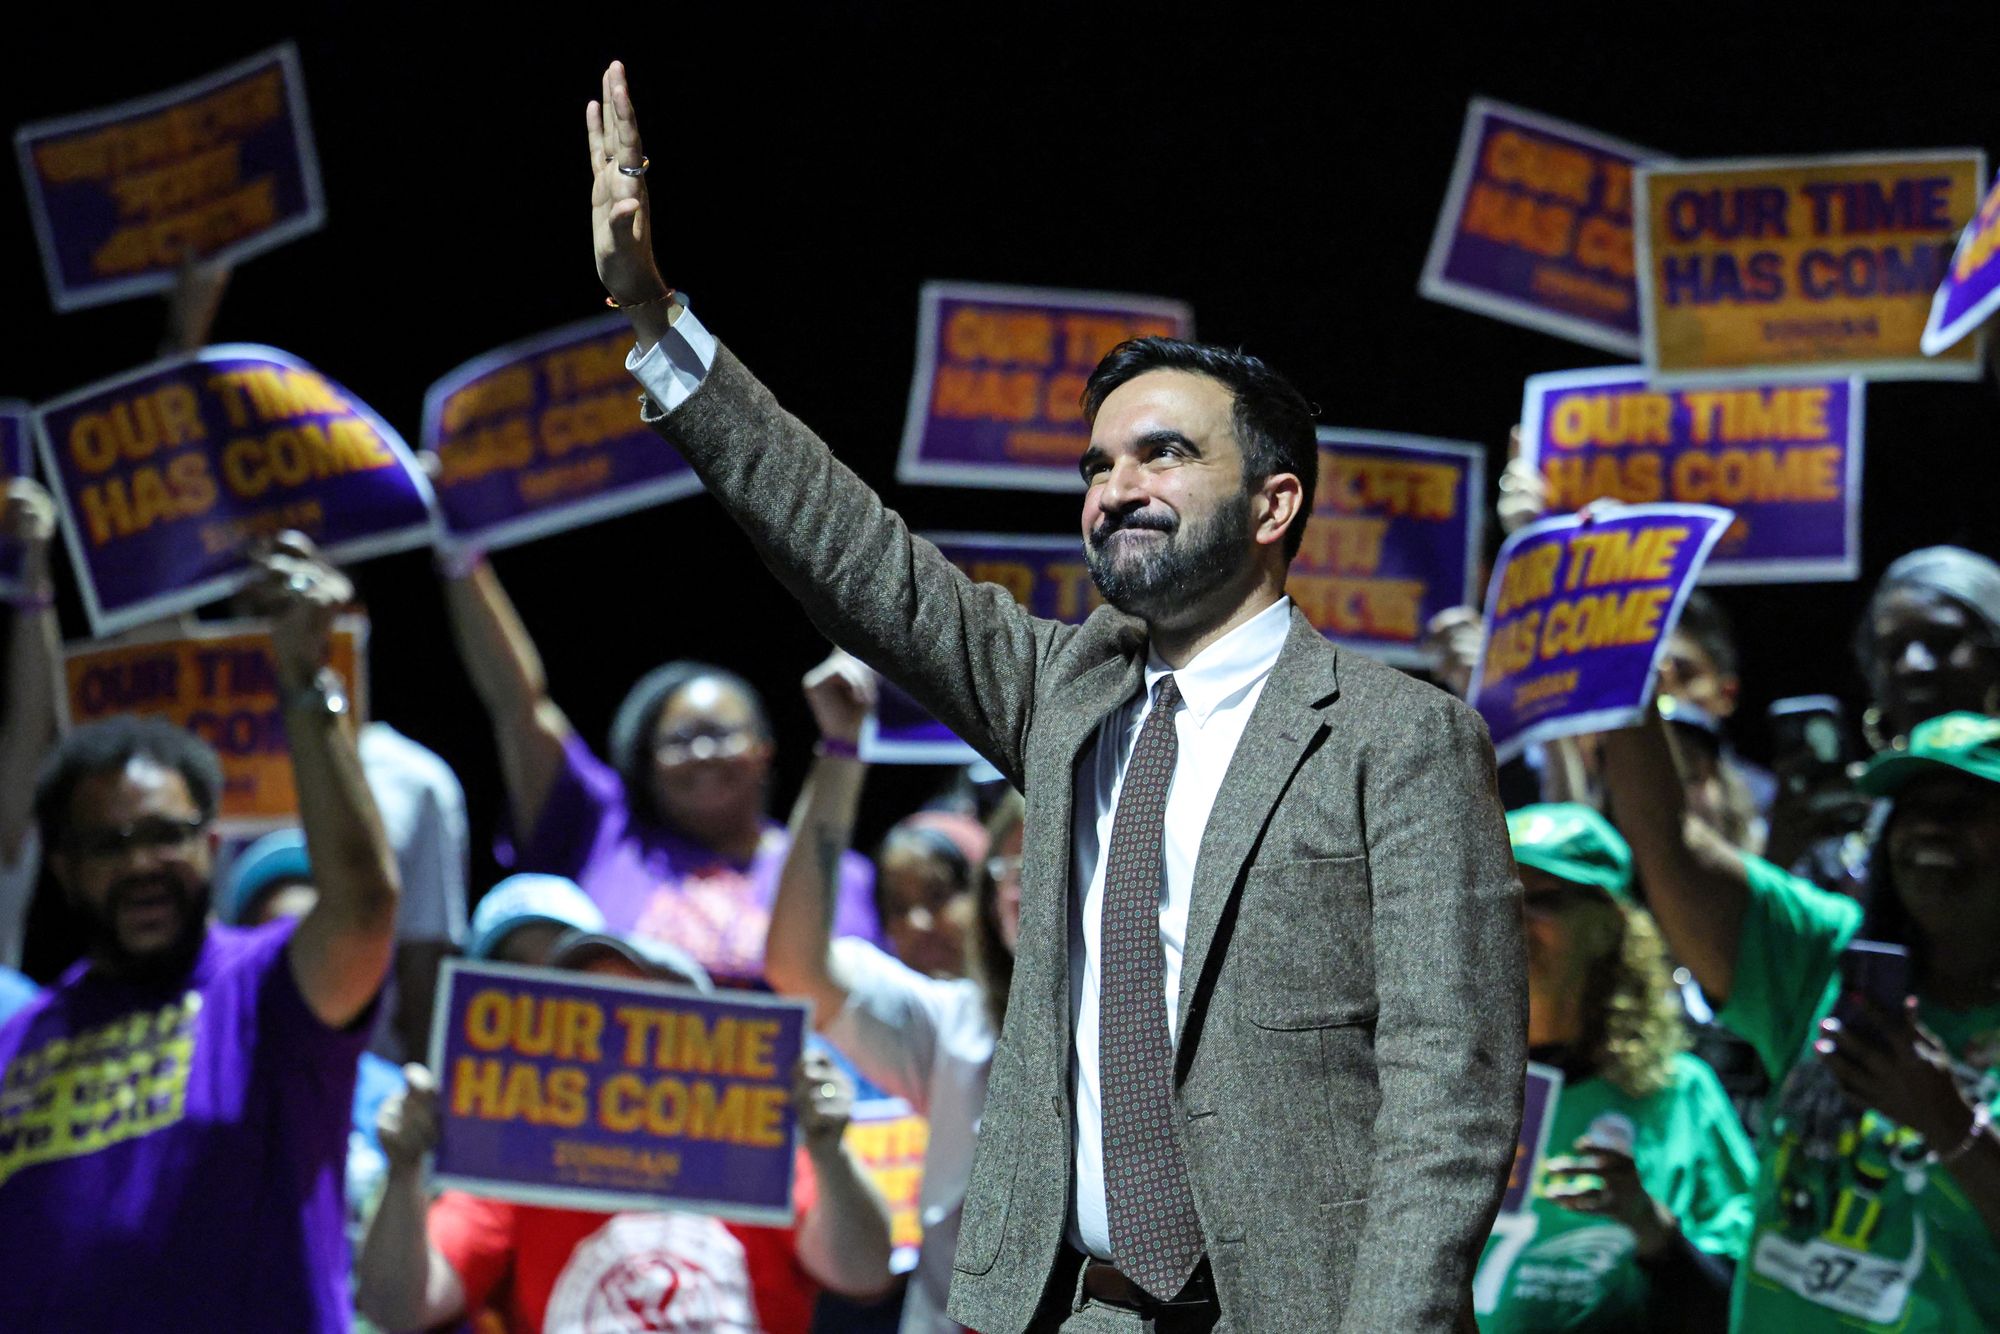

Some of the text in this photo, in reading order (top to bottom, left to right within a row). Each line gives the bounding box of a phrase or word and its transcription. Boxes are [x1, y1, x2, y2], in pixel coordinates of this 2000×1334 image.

[1665, 186, 1790, 244] OUR
[1804, 176, 1954, 238] TIME
[1662, 253, 1786, 306] HAS
[1800, 245, 1945, 301] COM
[944, 311, 1052, 365] OUR
[69, 382, 205, 474] OUR
[934, 368, 1038, 423] HAS
[1553, 388, 1831, 448] OUR TIME
[80, 451, 218, 548] HAS
[222, 417, 396, 498] COME
[1545, 446, 1842, 508] HAS COME
[1565, 526, 1690, 592] TIME
[1539, 586, 1672, 661] COME
[78, 652, 181, 718] OUR
[466, 988, 781, 1080] OUR TIME
[453, 1055, 590, 1129] HAS
[600, 1072, 788, 1148] COME
[1802, 1254, 1858, 1294] 37
